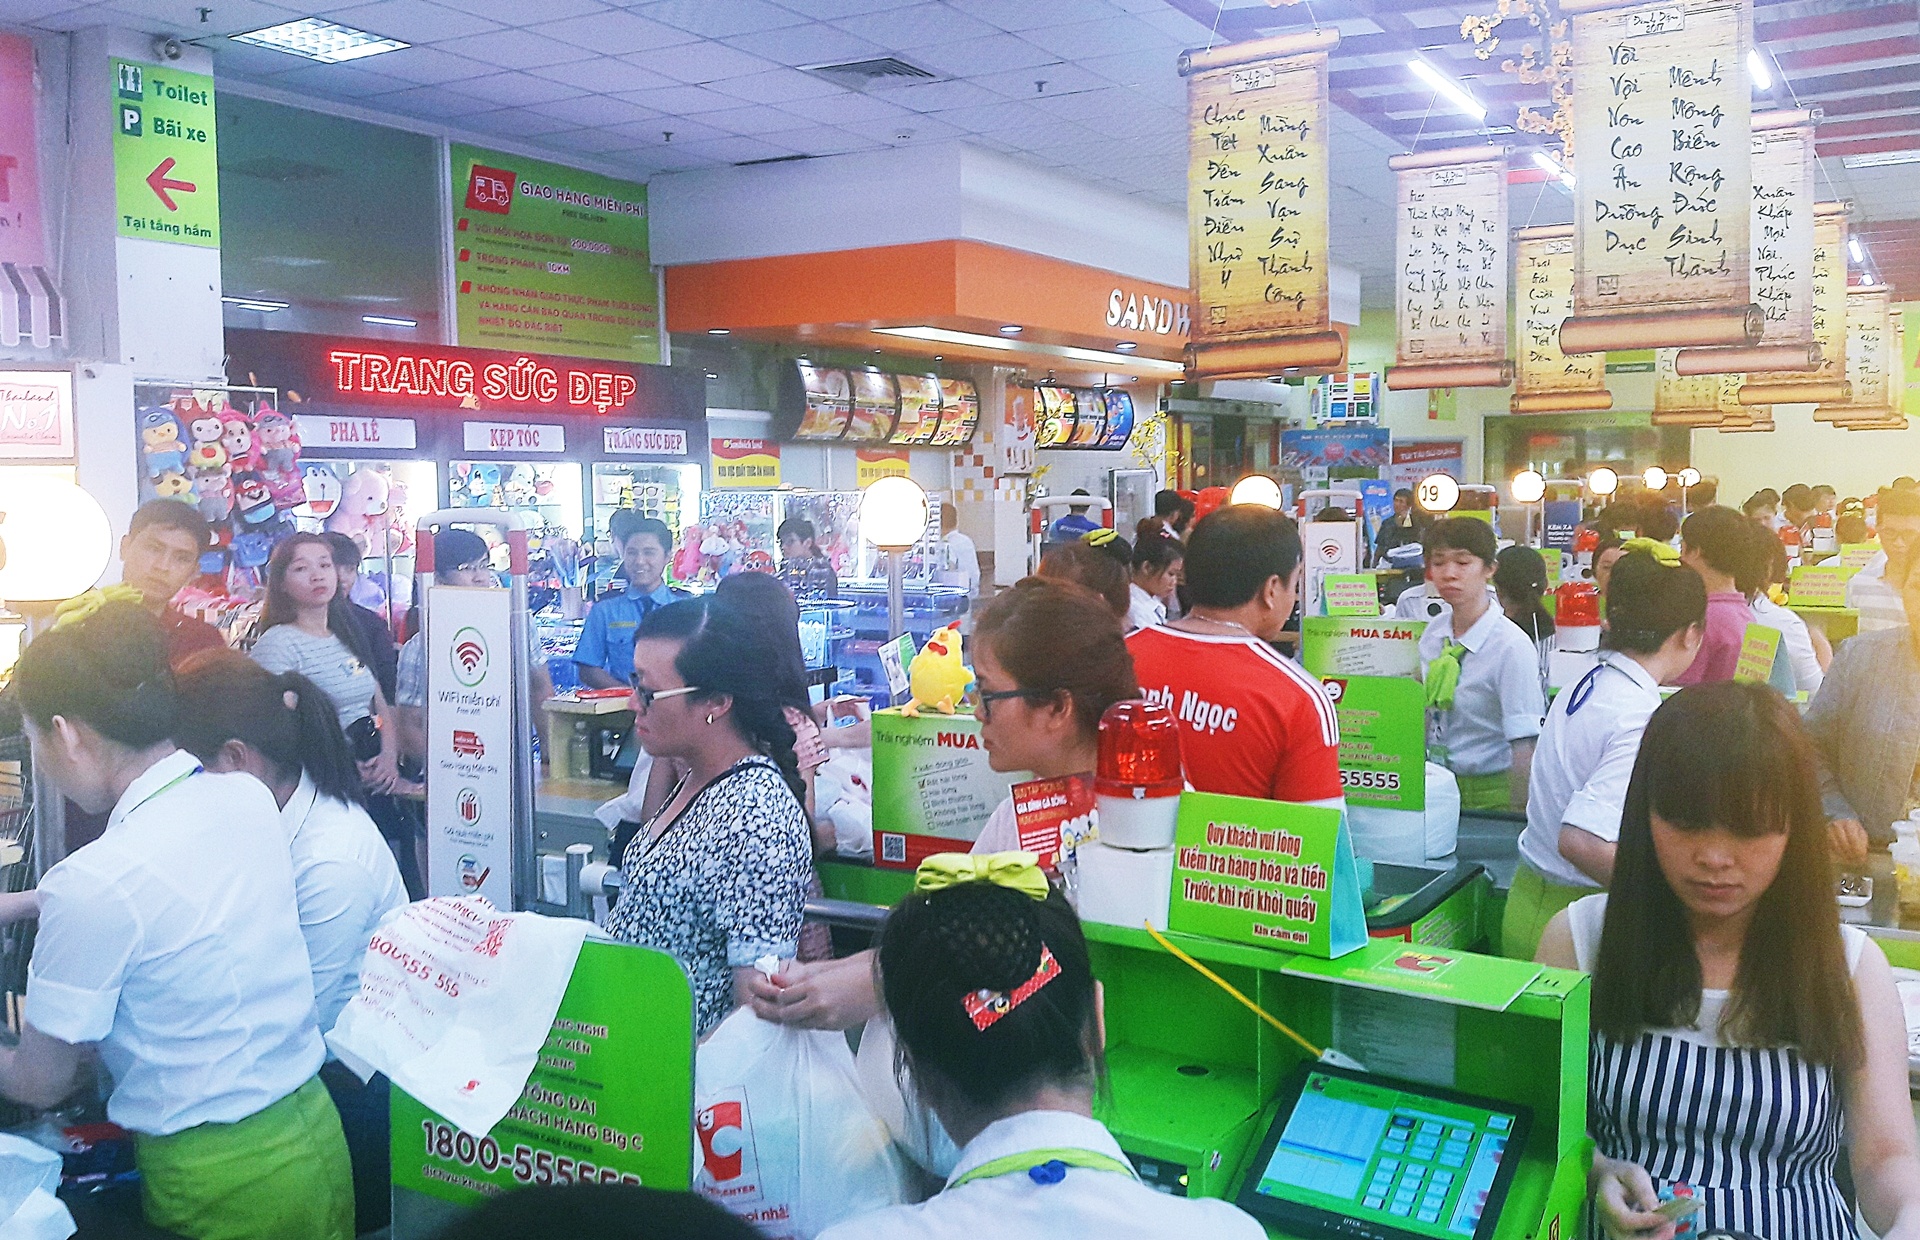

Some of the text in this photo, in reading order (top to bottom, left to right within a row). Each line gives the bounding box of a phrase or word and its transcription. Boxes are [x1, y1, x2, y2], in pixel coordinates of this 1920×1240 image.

[153, 80, 208, 106] Toilet
[1204, 98, 1247, 127] Chúc
[1608, 103, 1644, 128] Non
[153, 117, 207, 142] Bãi xe
[1210, 125, 1239, 152] Tết
[1611, 136, 1643, 160] Cao
[1207, 154, 1242, 180] Đến
[1612, 164, 1642, 192] Ân
[1663, 59, 1732, 280] Mênh Mông Biển Rộng Đức Sinh Thành
[520, 181, 552, 199] GIAO
[1203, 189, 1246, 208] Trăm
[1753, 184, 1795, 201] Xuân
[124, 215, 146, 231] Tại
[1257, 114, 1314, 312] Mừng Xuân Sang Vạn Sự Thành Công
[1596, 199, 1664, 229] Dưỡng
[1758, 199, 1794, 229] Khắp
[1605, 229, 1647, 255] Dục
[1763, 225, 1786, 240] Mọi
[1208, 241, 1243, 264] Như
[547, 261, 571, 275] 10KM
[1755, 264, 1796, 282] Phúc
[1757, 282, 1793, 313] Khắp
[330, 352, 639, 413] TRANG SỨC ĐẸP
[330, 421, 361, 442] PHA
[490, 425, 540, 450] KẸP TÓC
[1421, 484, 1439, 502] 19
[1350, 627, 1379, 639] MUA
[1383, 626, 1413, 640] SẮM
[1179, 690, 1238, 735] Ngọc
[876, 730, 979, 750] Trải nghiệm MUA
[1207, 822, 1301, 858] Quý khách vui lòng
[1179, 845, 1327, 891] Kiểm tra hàng hóa và tiền
[1184, 878, 1317, 923] Trước khi rời khỏi quầy
[1270, 926, 1291, 940] cảm
[434, 974, 460, 998] 555
[576, 1021, 609, 1039] NGHE
[568, 1094, 597, 1116] ĐÀI
[507, 1104, 550, 1127] HÁCH
[554, 1114, 598, 1141] HÀNG
[601, 1125, 628, 1152] Big
[631, 1132, 644, 1152] C
[422, 1120, 642, 1185] 1800-5555
